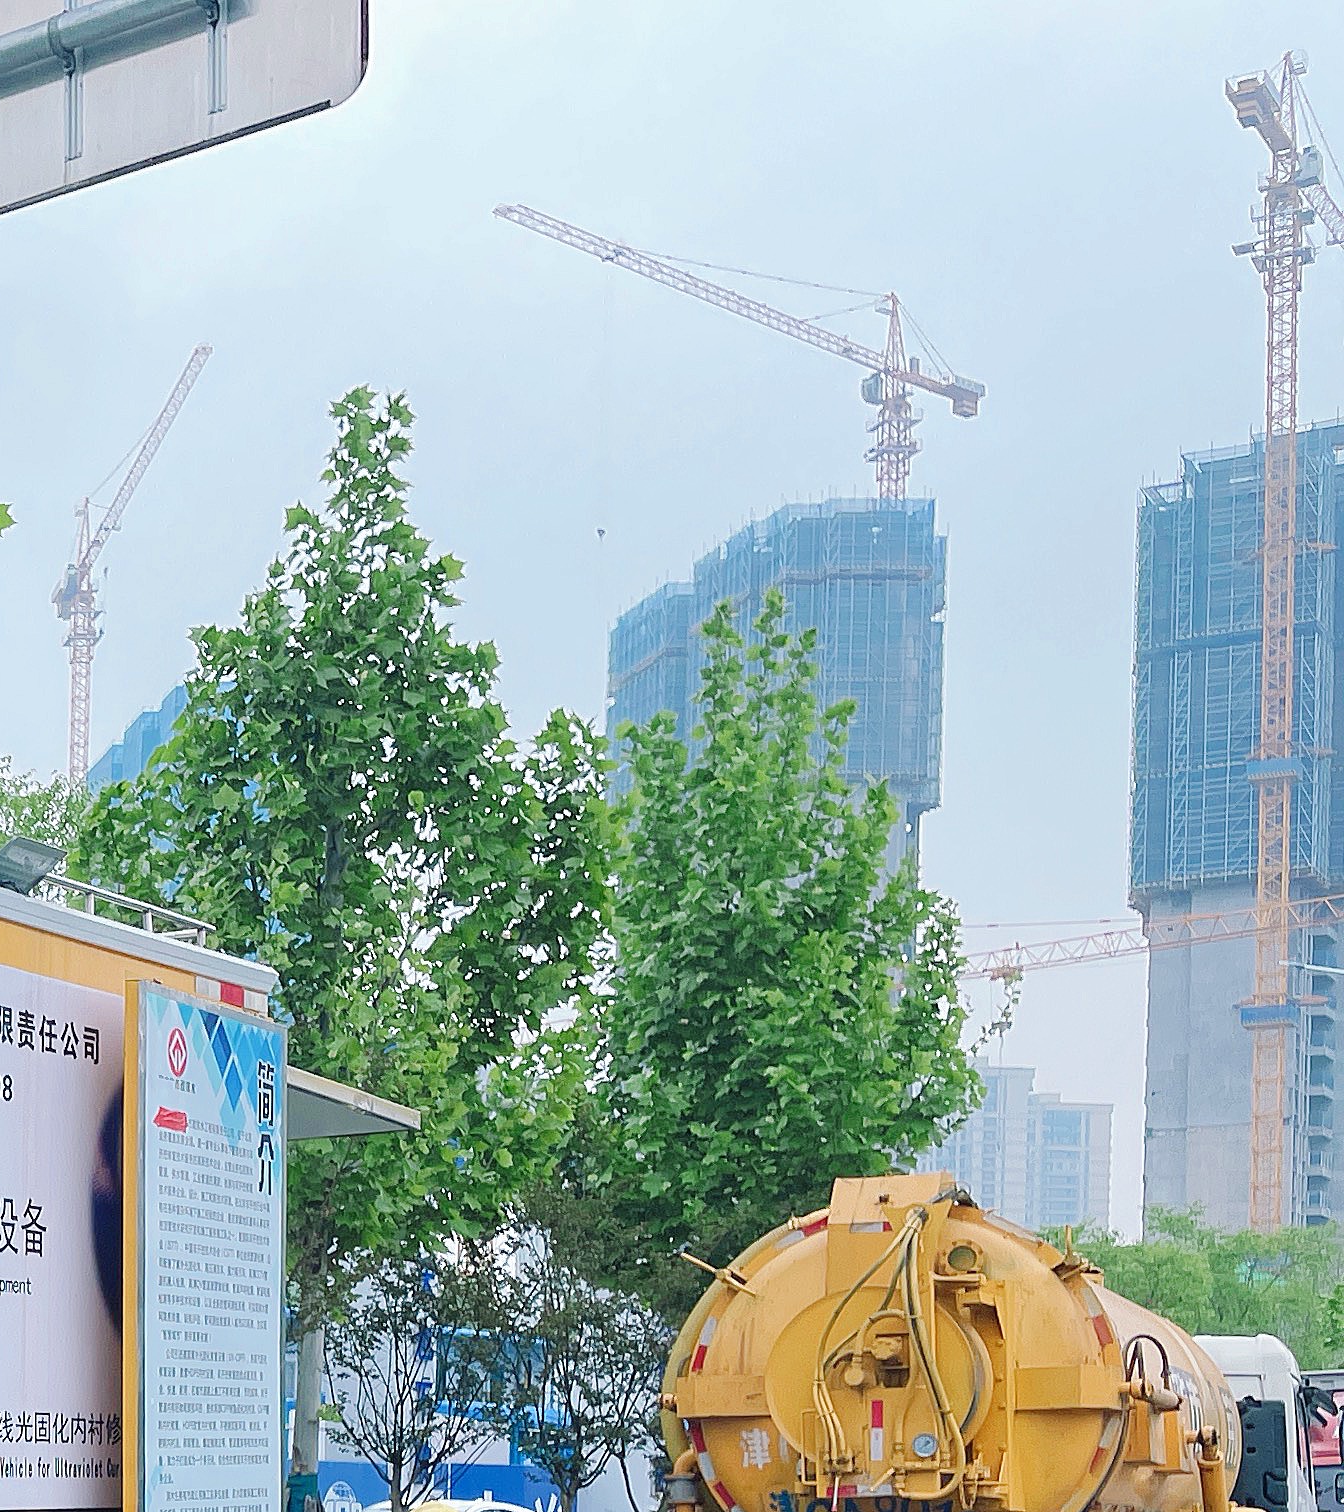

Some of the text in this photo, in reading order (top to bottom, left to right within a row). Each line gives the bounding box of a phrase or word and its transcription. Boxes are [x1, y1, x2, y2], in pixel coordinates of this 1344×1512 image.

[257, 1061, 275, 1196] 简介
[0, 1456, 33, 1479] Vehicle
[37, 1456, 51, 1479] for
[54, 1456, 104, 1479] Ultraviolet
